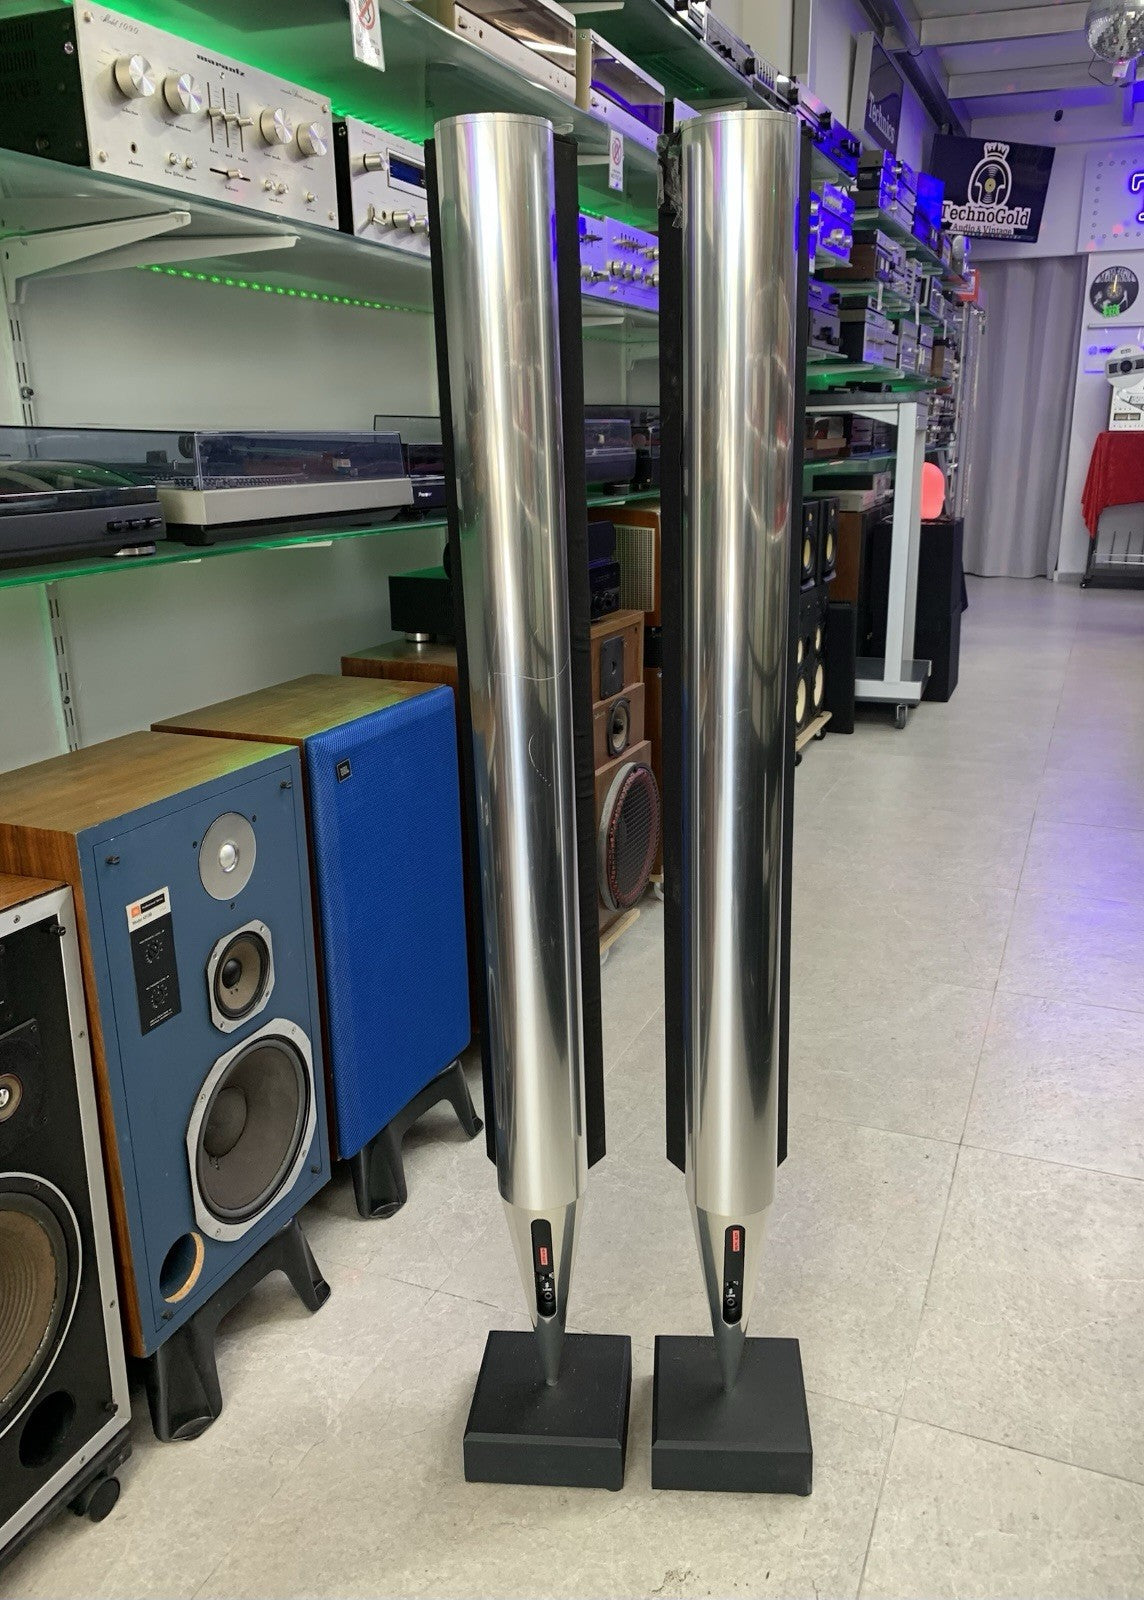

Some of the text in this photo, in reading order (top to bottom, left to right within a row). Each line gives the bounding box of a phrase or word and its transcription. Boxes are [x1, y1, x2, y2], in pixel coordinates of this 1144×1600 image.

[196, 53, 245, 77] marantz
[868, 90, 896, 144] Technics
[941, 203, 1029, 226] TechnoGold
[953, 223, 975, 233] Audio
